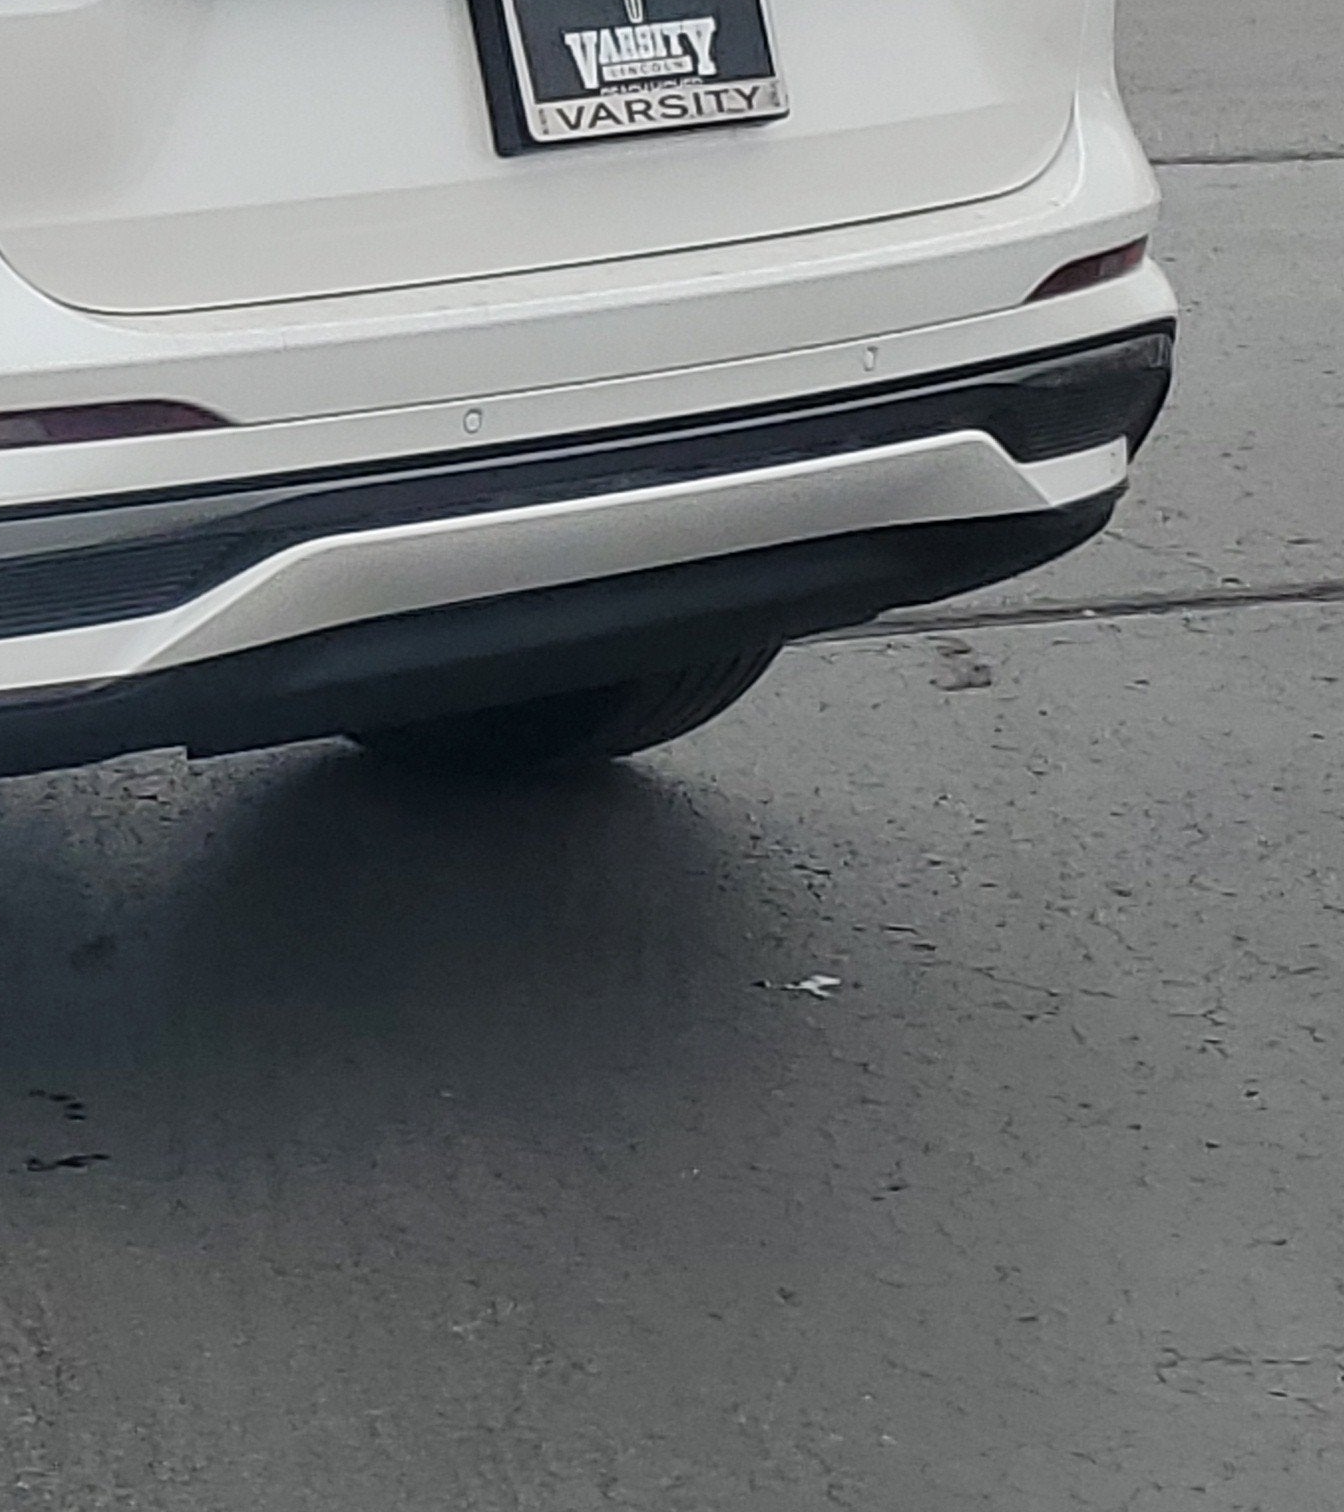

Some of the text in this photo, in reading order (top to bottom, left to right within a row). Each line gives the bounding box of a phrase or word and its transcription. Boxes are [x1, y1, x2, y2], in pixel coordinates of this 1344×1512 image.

[564, 17, 717, 89] VARSITY
[610, 59, 685, 75] LINCOLN
[556, 87, 760, 131] VARSITY
